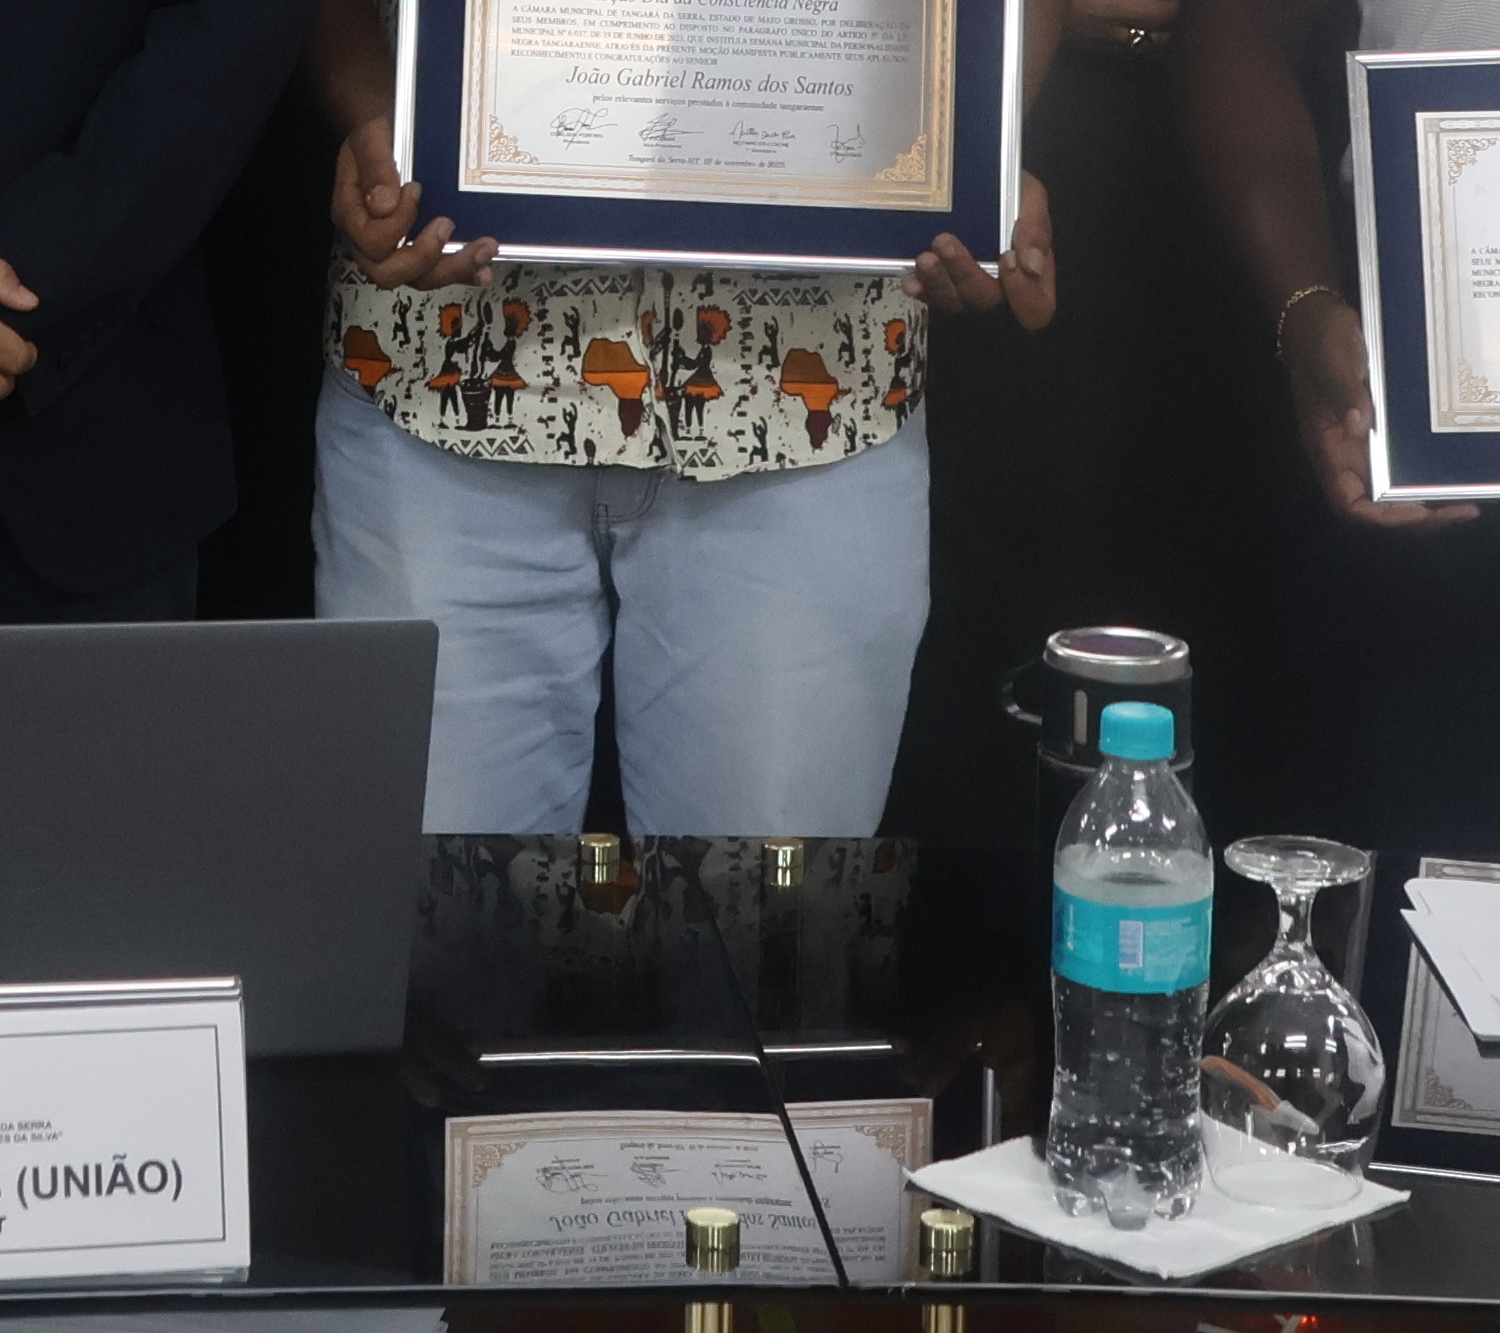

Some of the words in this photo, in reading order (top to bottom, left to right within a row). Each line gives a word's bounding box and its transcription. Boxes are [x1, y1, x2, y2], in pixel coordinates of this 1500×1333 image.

[512, 5, 519, 13] A
[521, 3, 557, 14] CÂMARA
[559, 6, 604, 17] MUNICIPAL
[606, 8, 618, 17] DE
[663, 11, 675, 20] DA
[565, 65, 611, 85] João
[616, 67, 687, 89] Gabriel
[691, 71, 753, 92] Ramos
[757, 73, 789, 94] dos
[793, 75, 854, 96] Santos
[593, 93, 613, 104] pelos
[615, 95, 653, 105] relevantes
[0, 1122, 15, 1133] DA
[13, 1132, 29, 1143] DA
[17, 1151, 184, 1210] (UNIÃO)
